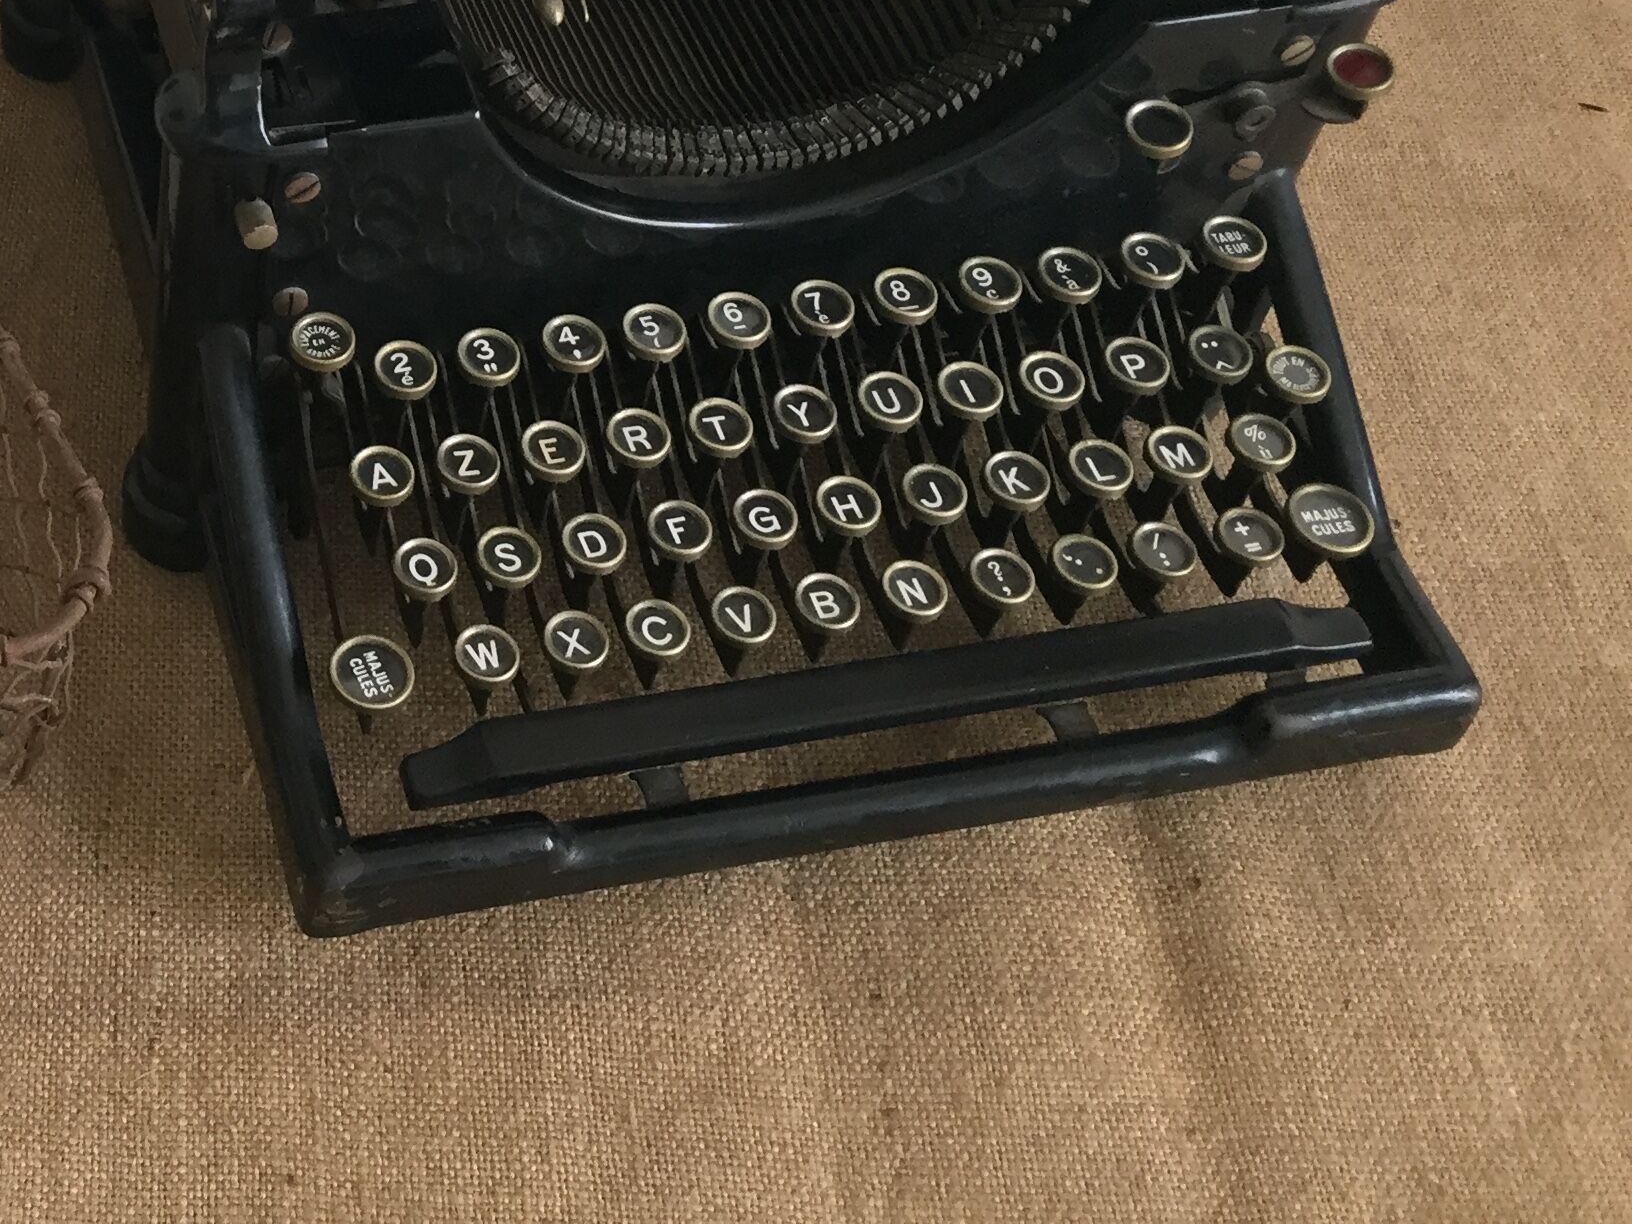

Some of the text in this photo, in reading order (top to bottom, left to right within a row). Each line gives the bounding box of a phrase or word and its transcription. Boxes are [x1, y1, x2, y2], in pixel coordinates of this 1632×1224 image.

[1218, 241, 1252, 256] LEUR
[371, 353, 1146, 491] A Z E R T Y U I O P
[408, 442, 1196, 587] Q S D F G H J K L M
[1300, 506, 1353, 523] MAJUS-
[1310, 519, 1356, 536] CULES
[464, 577, 929, 672] W X C V B N
